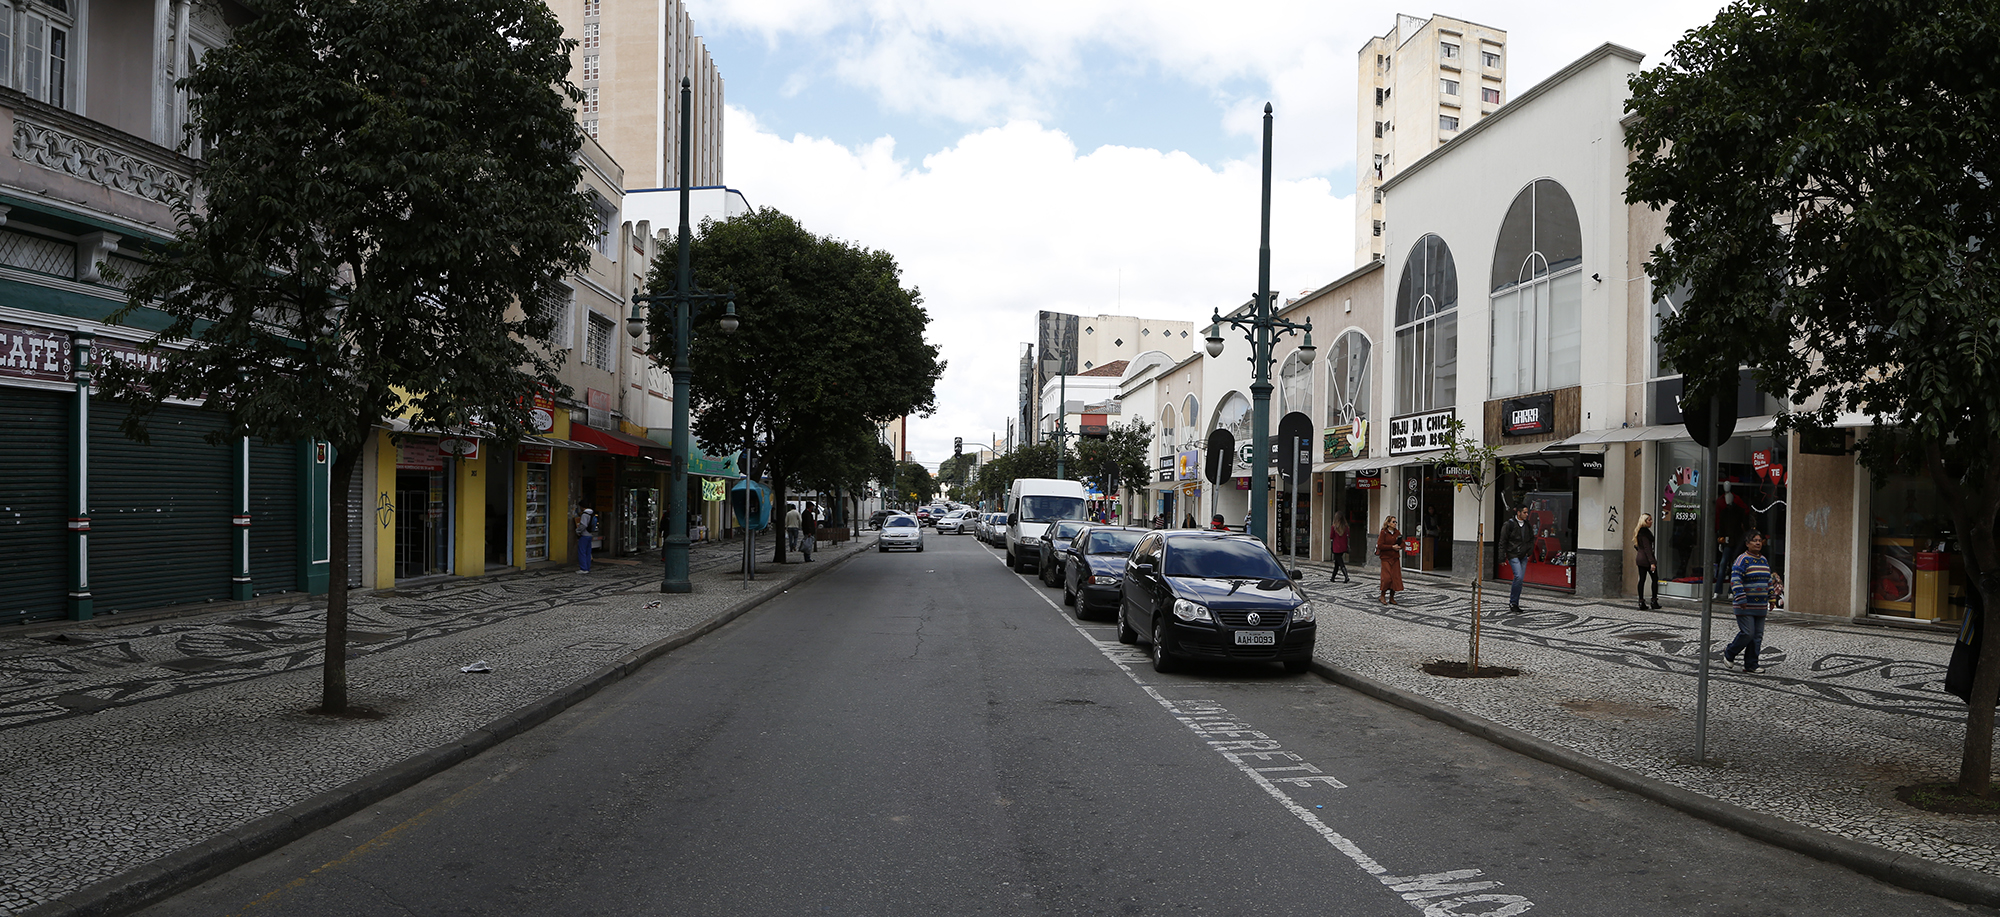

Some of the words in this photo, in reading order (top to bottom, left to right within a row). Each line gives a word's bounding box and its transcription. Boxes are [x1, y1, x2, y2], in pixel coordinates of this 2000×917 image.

[1512, 408, 1539, 425] GARRA
[1392, 421, 1408, 436] BIJU
[1413, 418, 1423, 433] DA
[1411, 433, 1426, 447] ÚNICO
[1771, 468, 1781, 477] TE
